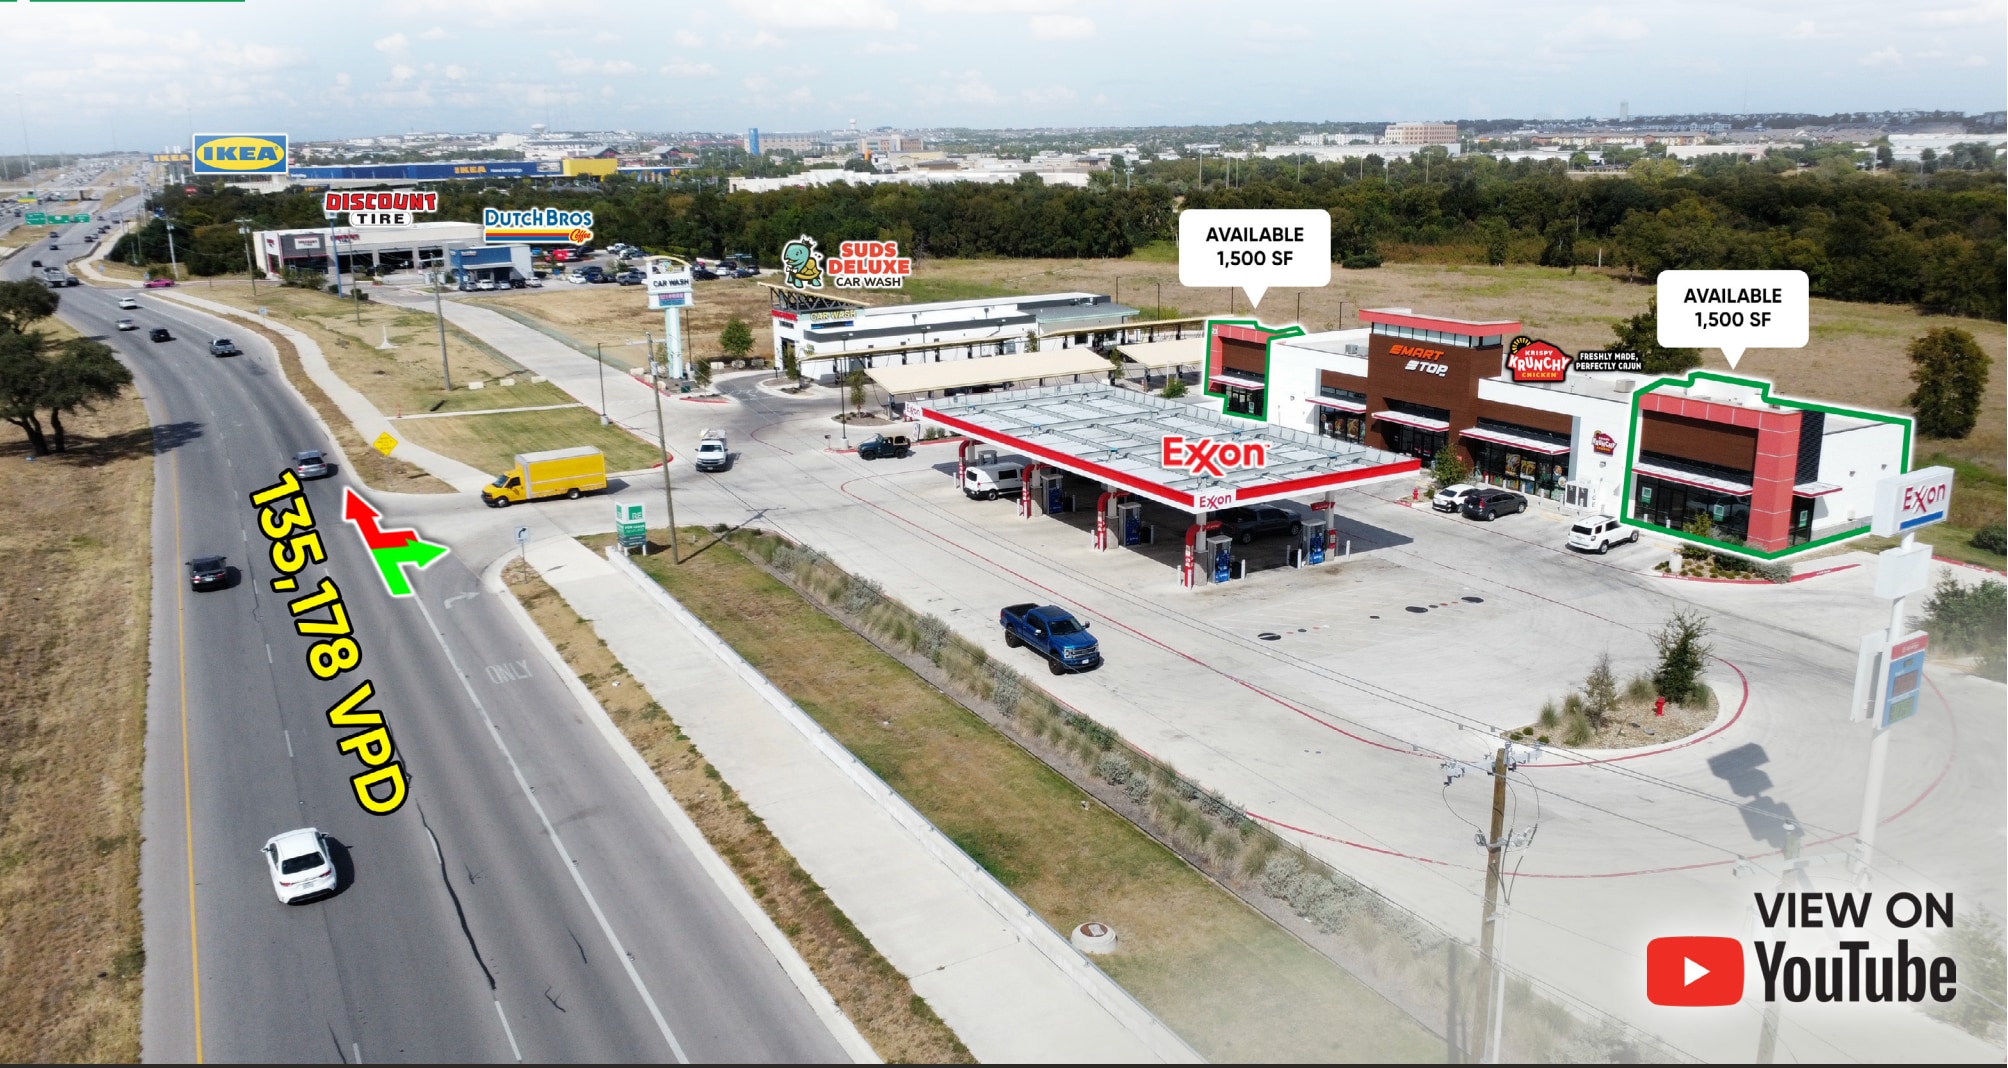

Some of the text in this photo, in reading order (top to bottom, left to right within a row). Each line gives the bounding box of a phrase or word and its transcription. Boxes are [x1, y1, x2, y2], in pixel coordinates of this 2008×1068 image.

[153, 154, 190, 162] IKEA
[454, 166, 487, 174] IKEA
[810, 310, 857, 321] CAR WASH
[1388, 344, 1445, 361] SMART
[1404, 359, 1449, 375] STOP
[1199, 494, 1232, 510] Exxon
[1902, 483, 1946, 513] Exxon
[485, 659, 533, 685] ONLY
